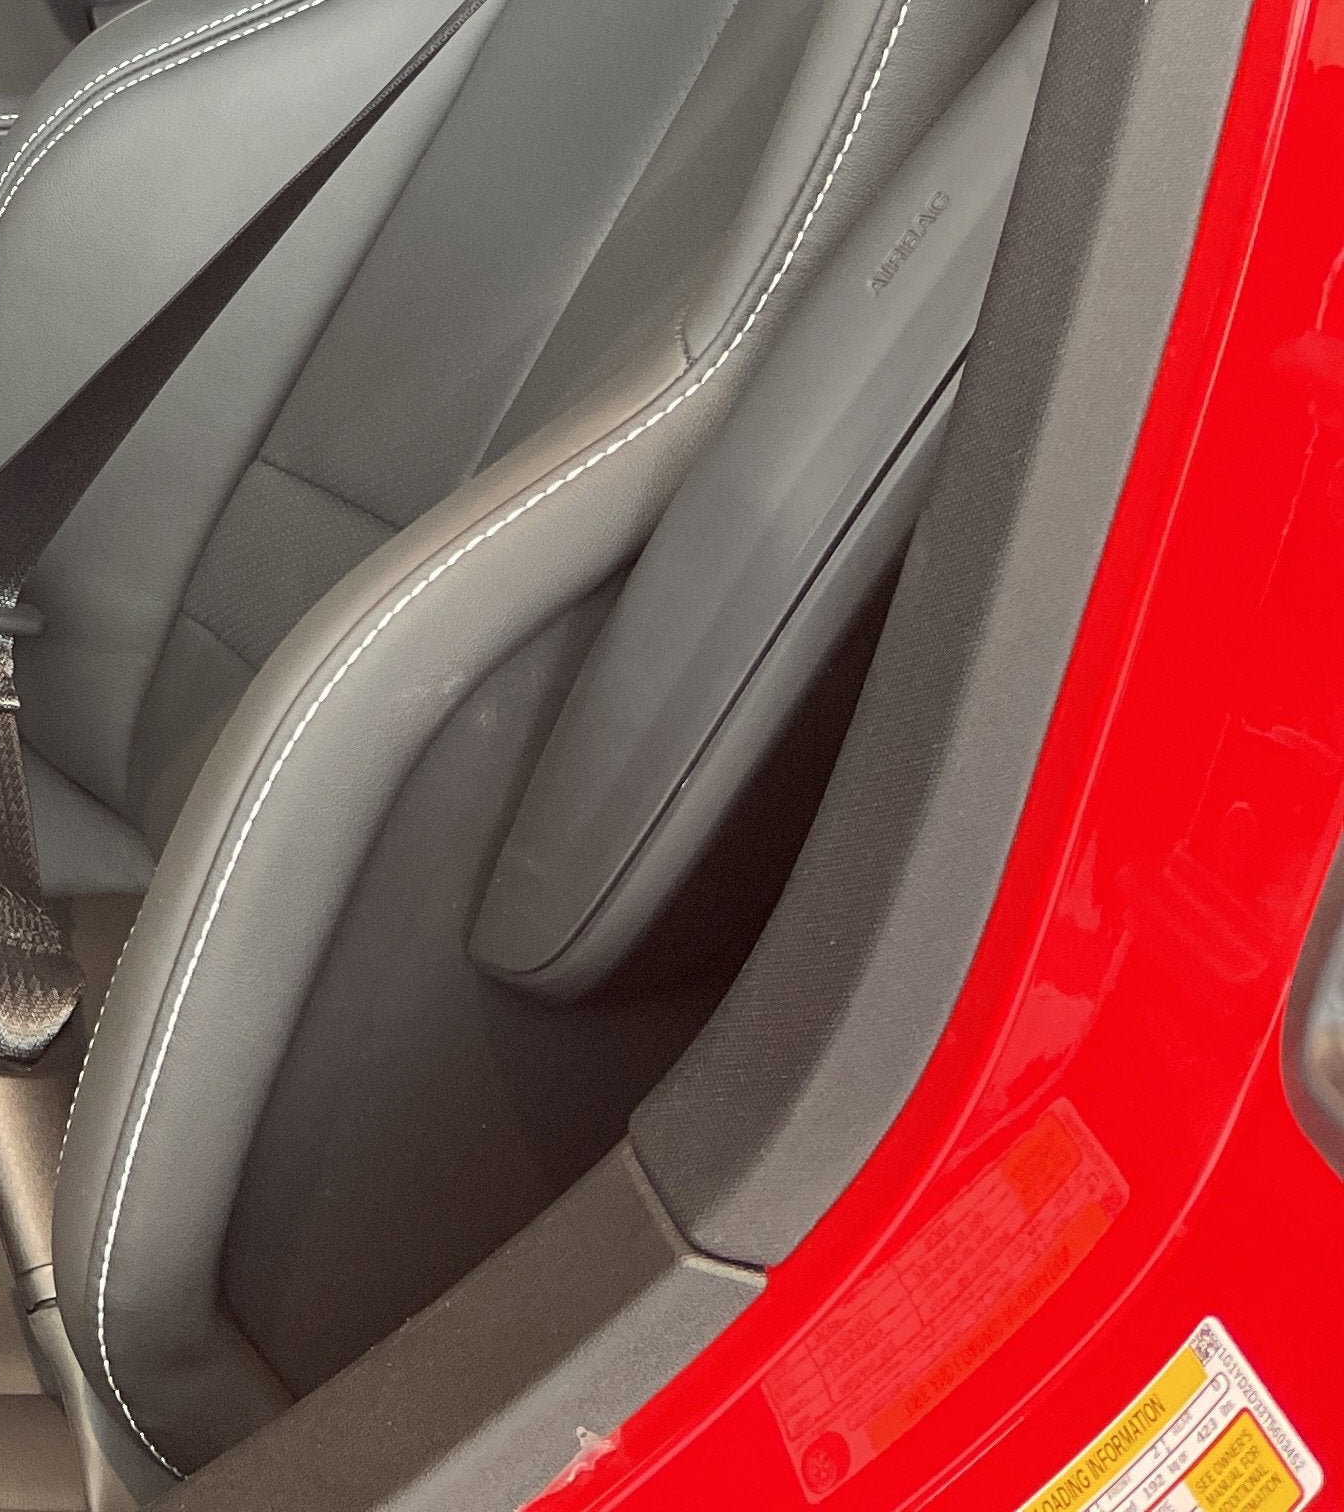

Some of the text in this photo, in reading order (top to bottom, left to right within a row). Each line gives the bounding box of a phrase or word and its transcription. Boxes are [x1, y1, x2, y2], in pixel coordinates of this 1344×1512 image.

[871, 191, 950, 297] AIRBAG
[1086, 1396, 1166, 1481] INFORMATION
[1143, 1473, 1165, 1500] 192
[1196, 1417, 1217, 1444] 423
[1195, 1428, 1253, 1494] SEE OWNER'S
[1205, 1444, 1260, 1506] MANUAL FOR
